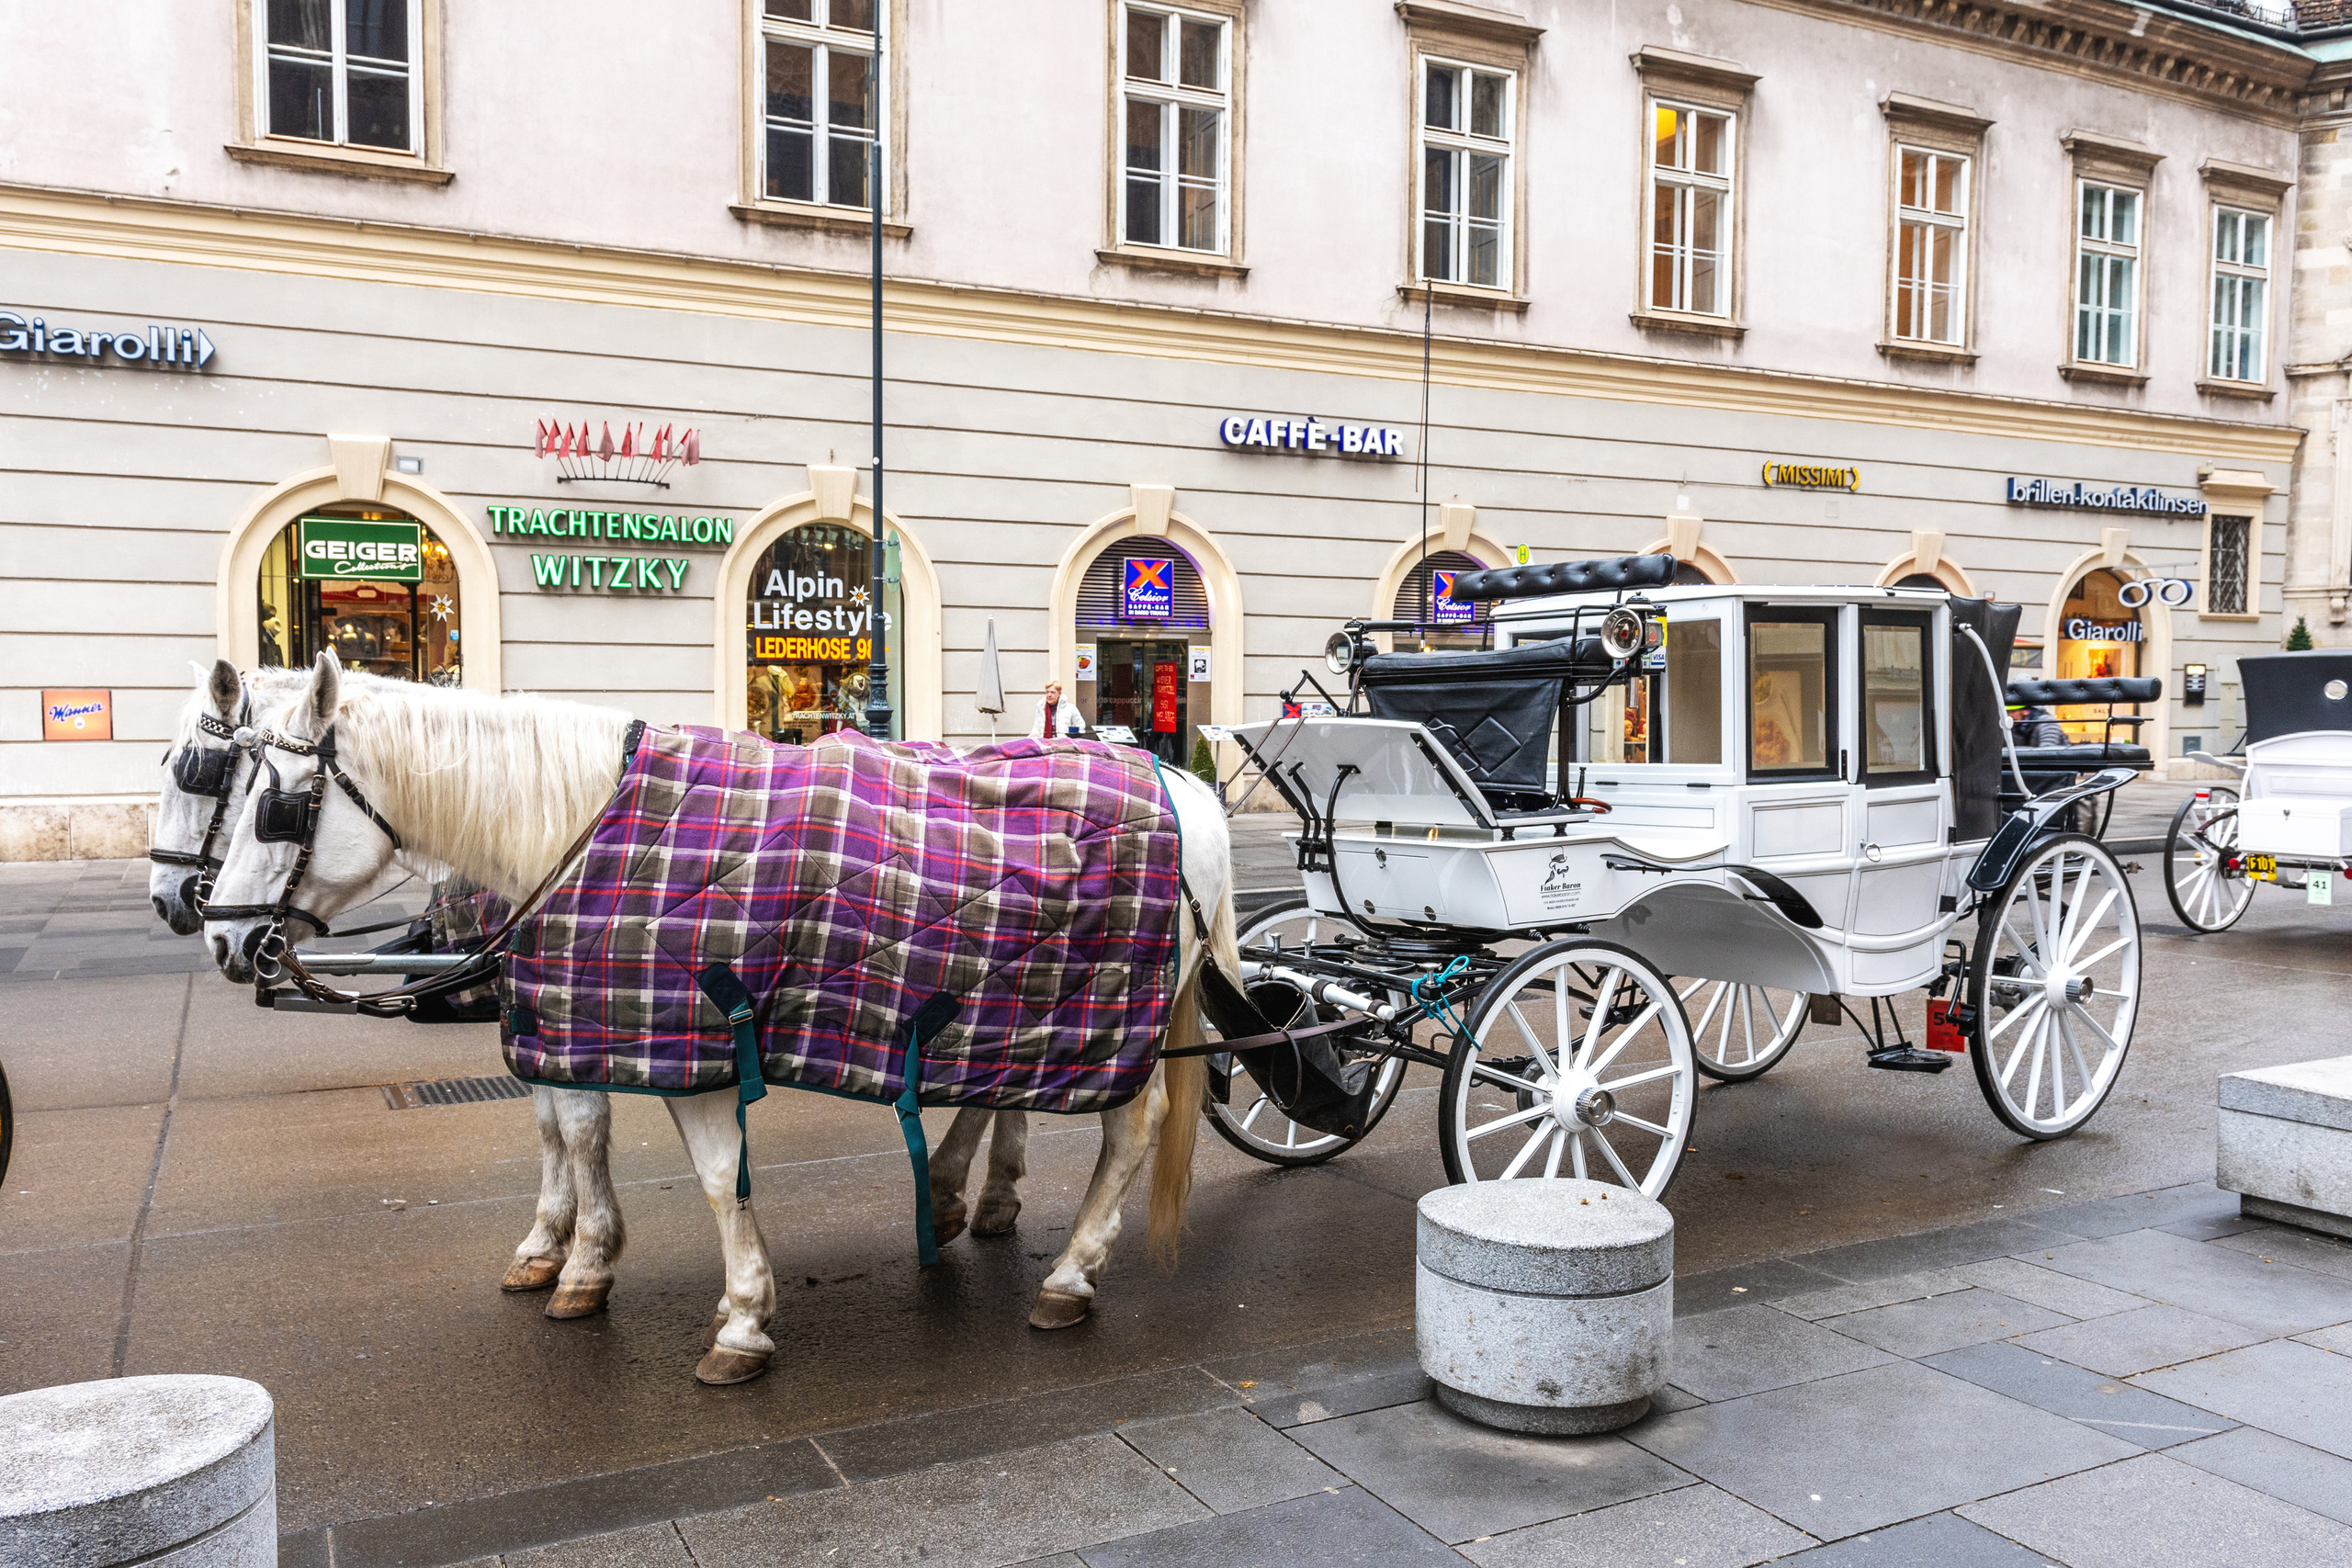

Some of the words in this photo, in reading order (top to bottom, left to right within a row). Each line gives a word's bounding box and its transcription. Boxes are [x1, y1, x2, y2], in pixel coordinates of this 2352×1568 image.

[0, 311, 193, 363] Giarolli
[1221, 416, 1404, 456] CAFFÈ-BAR
[2009, 478, 2210, 514] brillen-kontaktlinsen
[488, 505, 733, 544] TRACHTENSALON
[305, 540, 418, 562] GEIGER
[531, 554, 689, 589] WITZKY
[763, 570, 843, 603] Alpin
[1127, 587, 1169, 602] Celsior
[2067, 618, 2143, 642] Giarolli
[755, 637, 852, 660] LEDERHOSE
[49, 704, 105, 722] Manner
[791, 712, 856, 720] TRACHTENWITZKY.AT
[1562, 882, 1581, 890] Baron
[2312, 880, 2327, 889] 41
